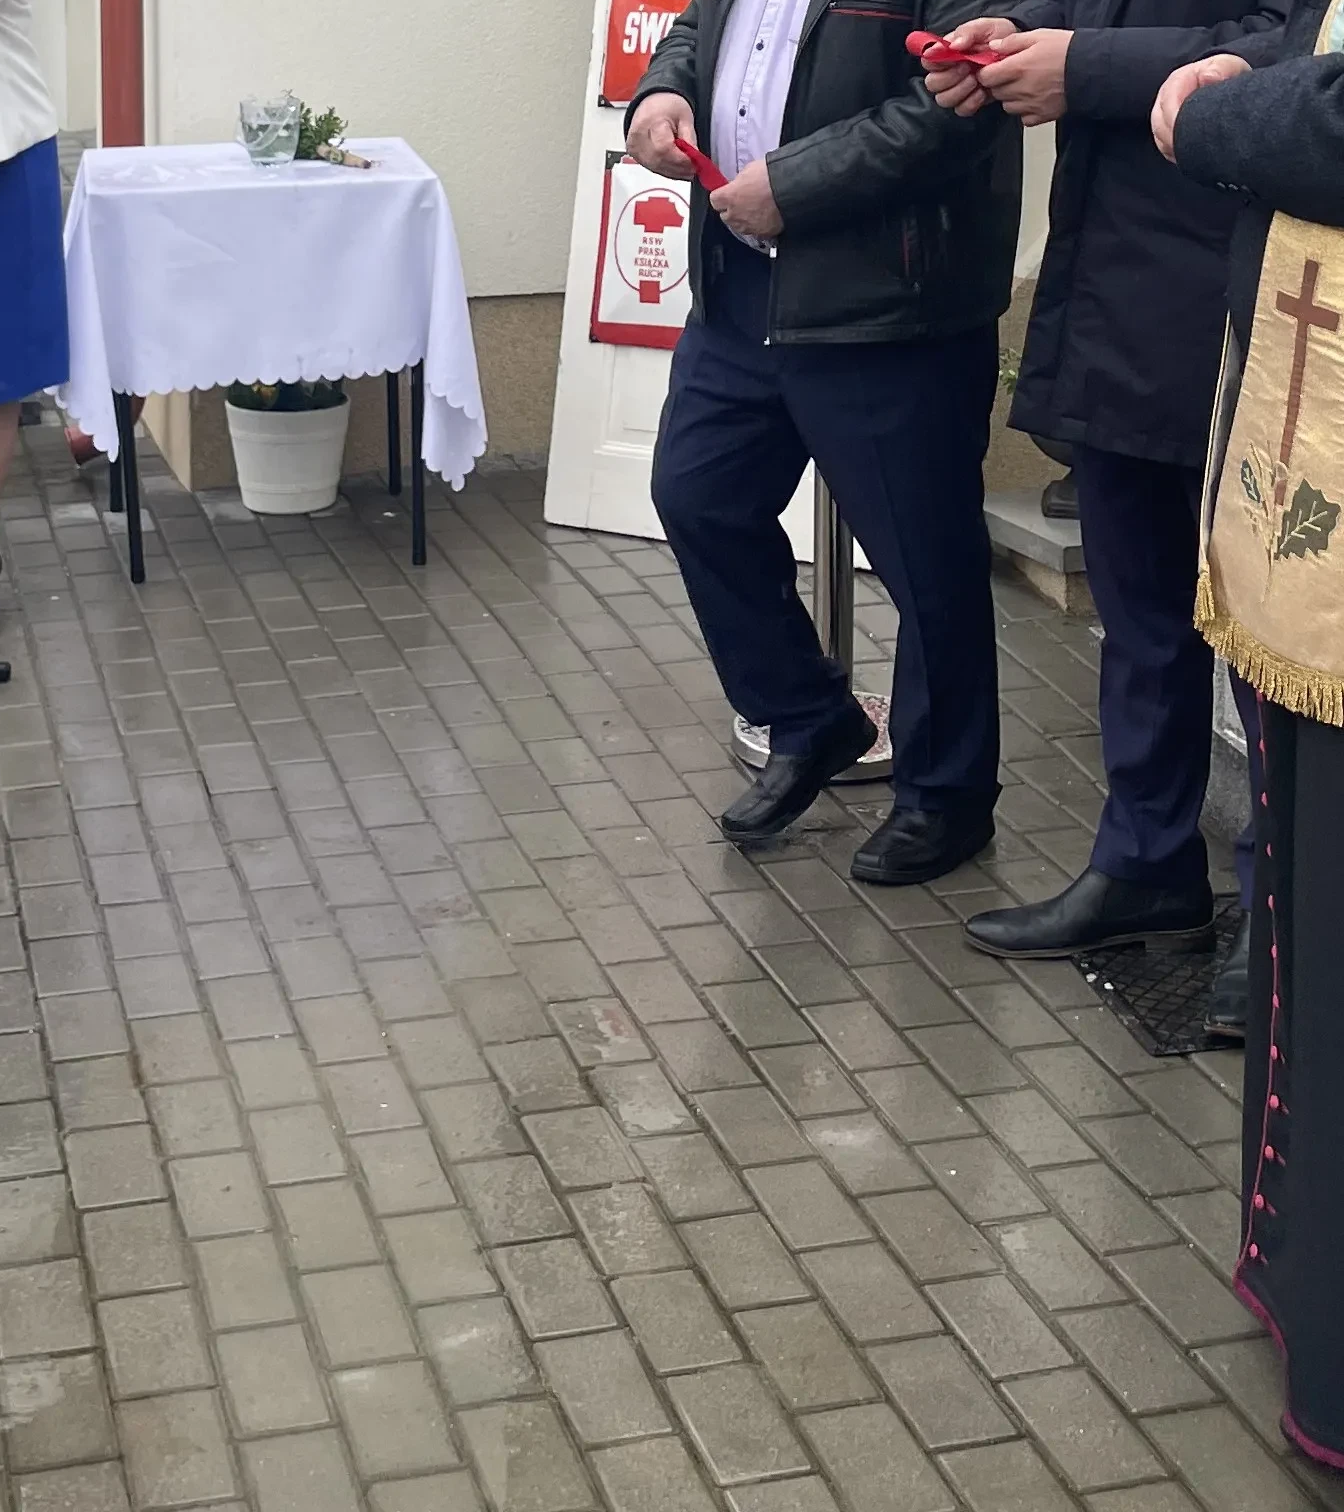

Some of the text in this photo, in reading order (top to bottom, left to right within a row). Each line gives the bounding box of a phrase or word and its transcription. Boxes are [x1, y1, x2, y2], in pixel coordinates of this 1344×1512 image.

[642, 236, 663, 245] RSW
[638, 246, 665, 257] PRASA
[638, 268, 663, 278] RUCH
